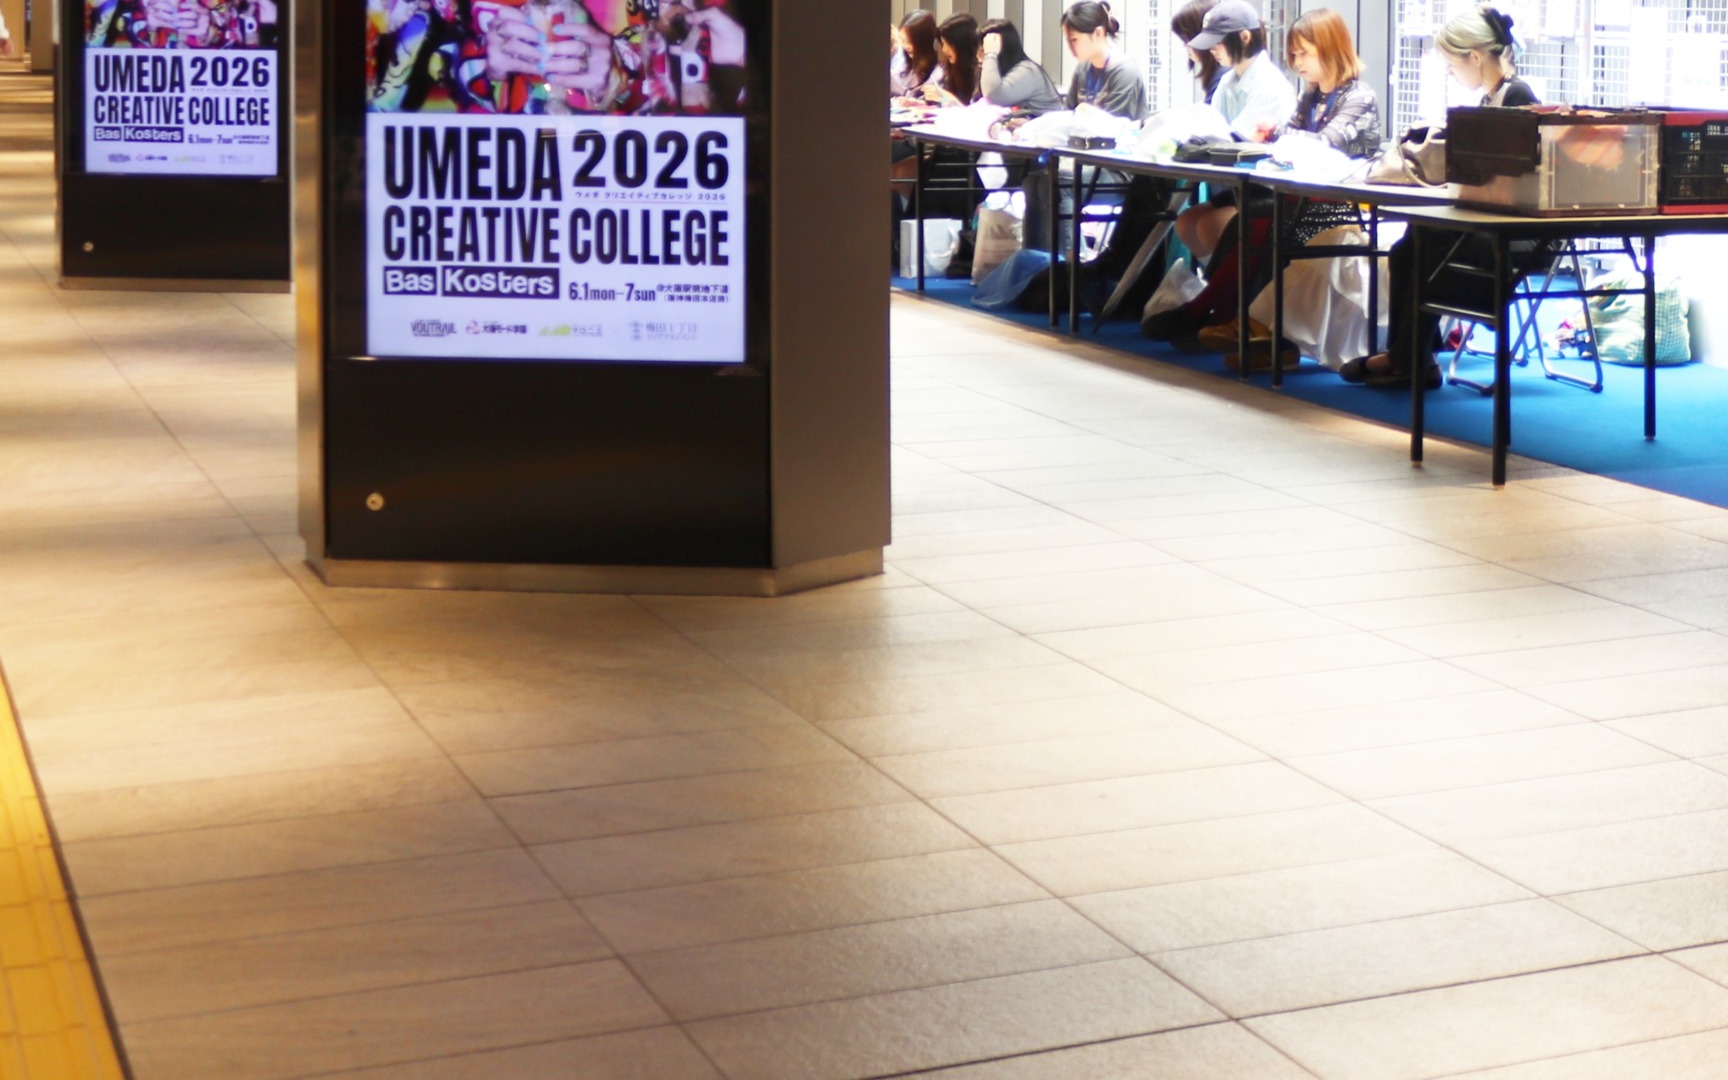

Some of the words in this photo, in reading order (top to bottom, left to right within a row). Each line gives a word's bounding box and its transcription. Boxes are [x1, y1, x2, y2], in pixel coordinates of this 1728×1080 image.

[94, 55, 185, 93] UMEDA
[190, 57, 270, 87] 2026
[94, 95, 185, 124] CREATIVE
[188, 96, 270, 126] COLLEGE
[95, 128, 121, 140] Bas
[125, 127, 181, 141] Kosters
[383, 125, 563, 201] UMEDA
[572, 129, 729, 189] 2026
[383, 205, 561, 263] CREATIVE
[569, 207, 729, 266] COLLEGE
[385, 270, 435, 293] Bas
[445, 269, 555, 295] Kosters
